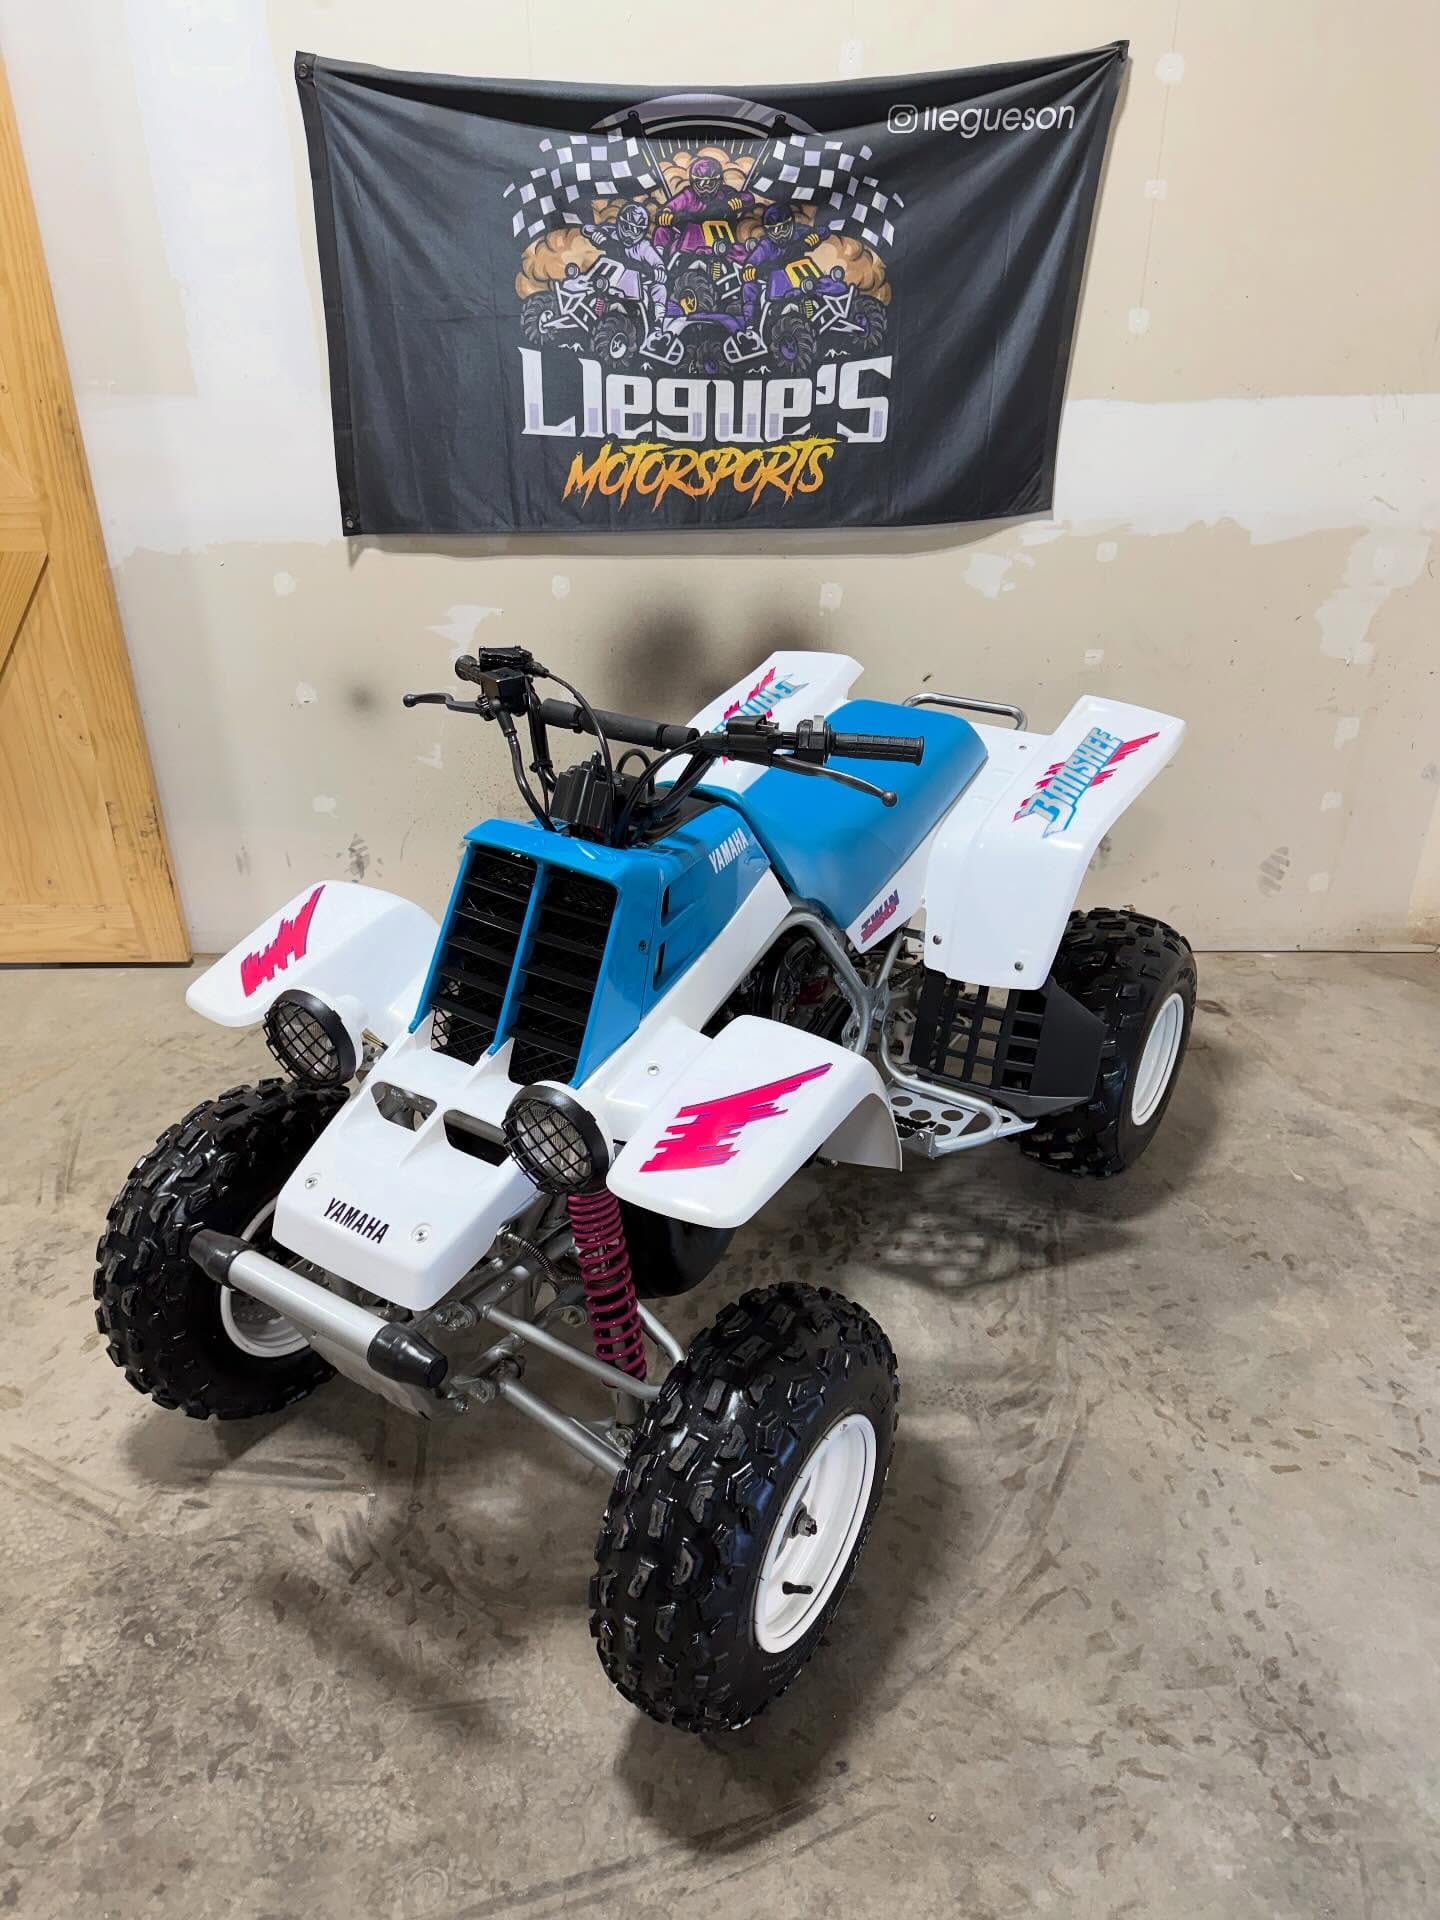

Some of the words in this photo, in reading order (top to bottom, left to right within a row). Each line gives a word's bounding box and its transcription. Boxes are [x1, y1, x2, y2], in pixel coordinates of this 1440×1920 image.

[560, 435, 842, 512] MOTORSPORTS
[1014, 727, 1124, 839] BANSHEE
[708, 827, 749, 875] YAMAHA
[323, 1197, 390, 1244] YAMAHA
